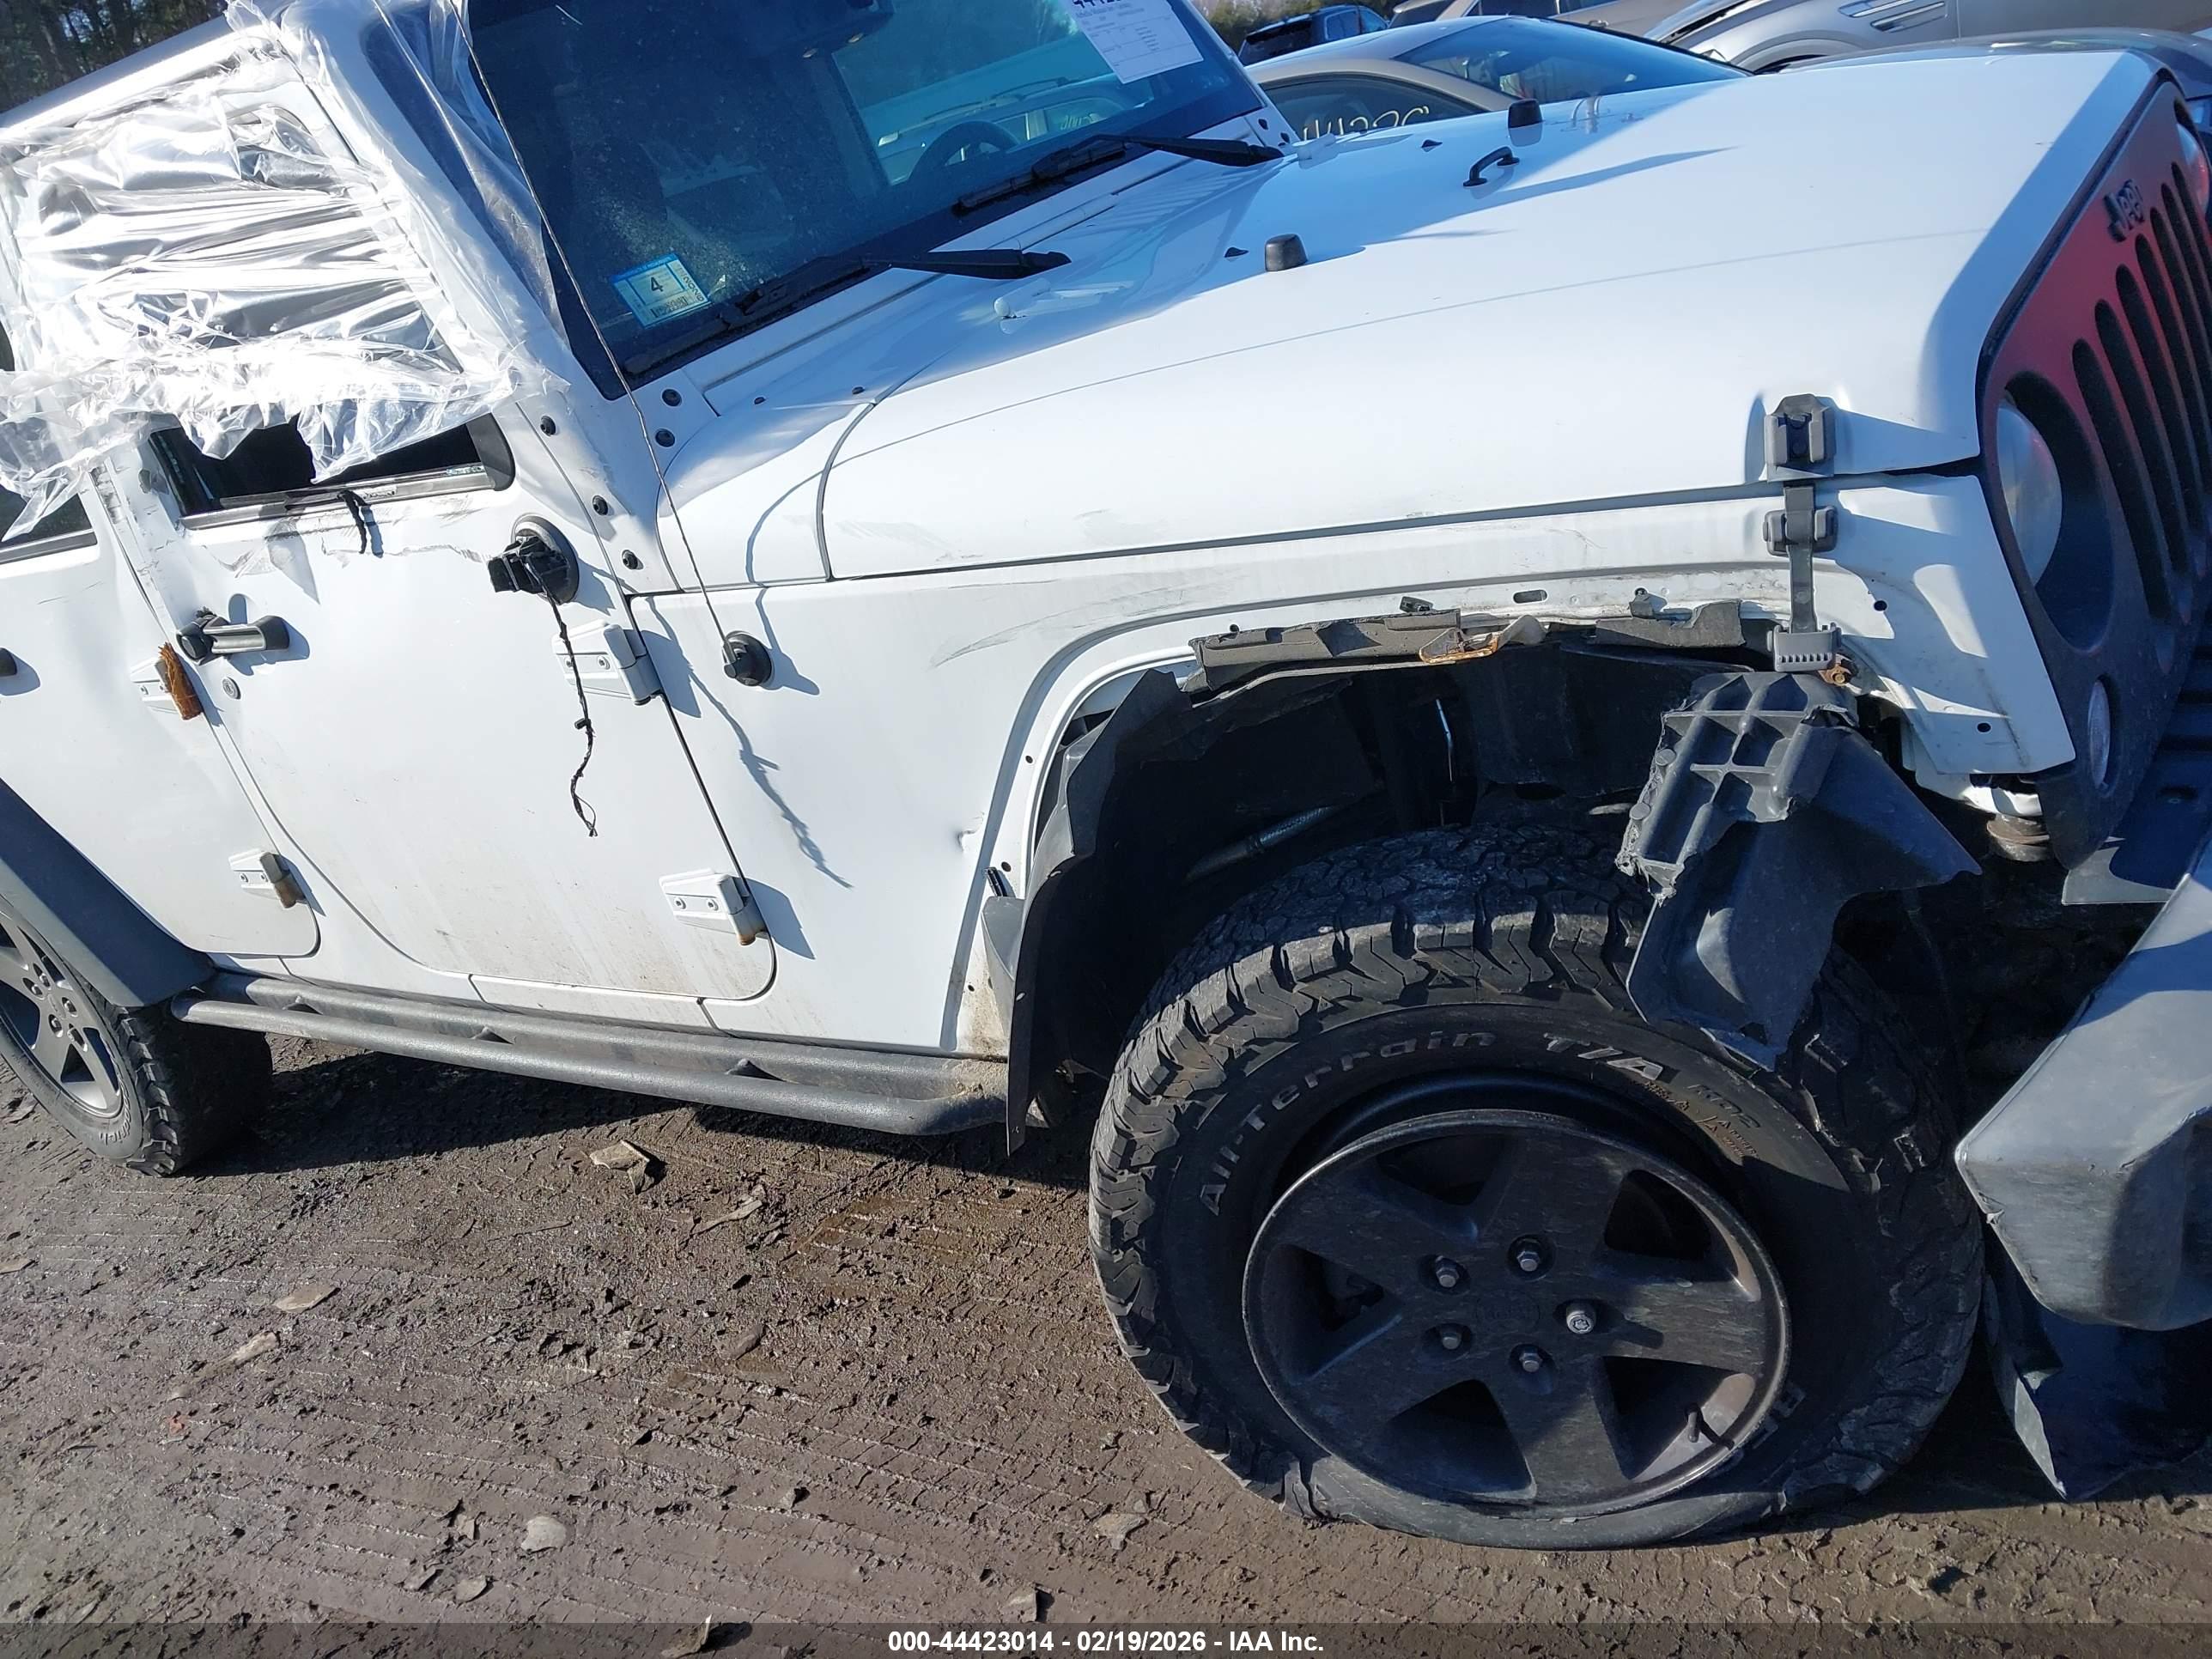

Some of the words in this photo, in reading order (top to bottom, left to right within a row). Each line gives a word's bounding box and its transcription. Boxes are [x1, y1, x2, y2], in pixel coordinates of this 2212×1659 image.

[650, 276, 664, 293] 4
[683, 276, 705, 302] 2026
[1543, 1032, 1664, 1081] T/A
